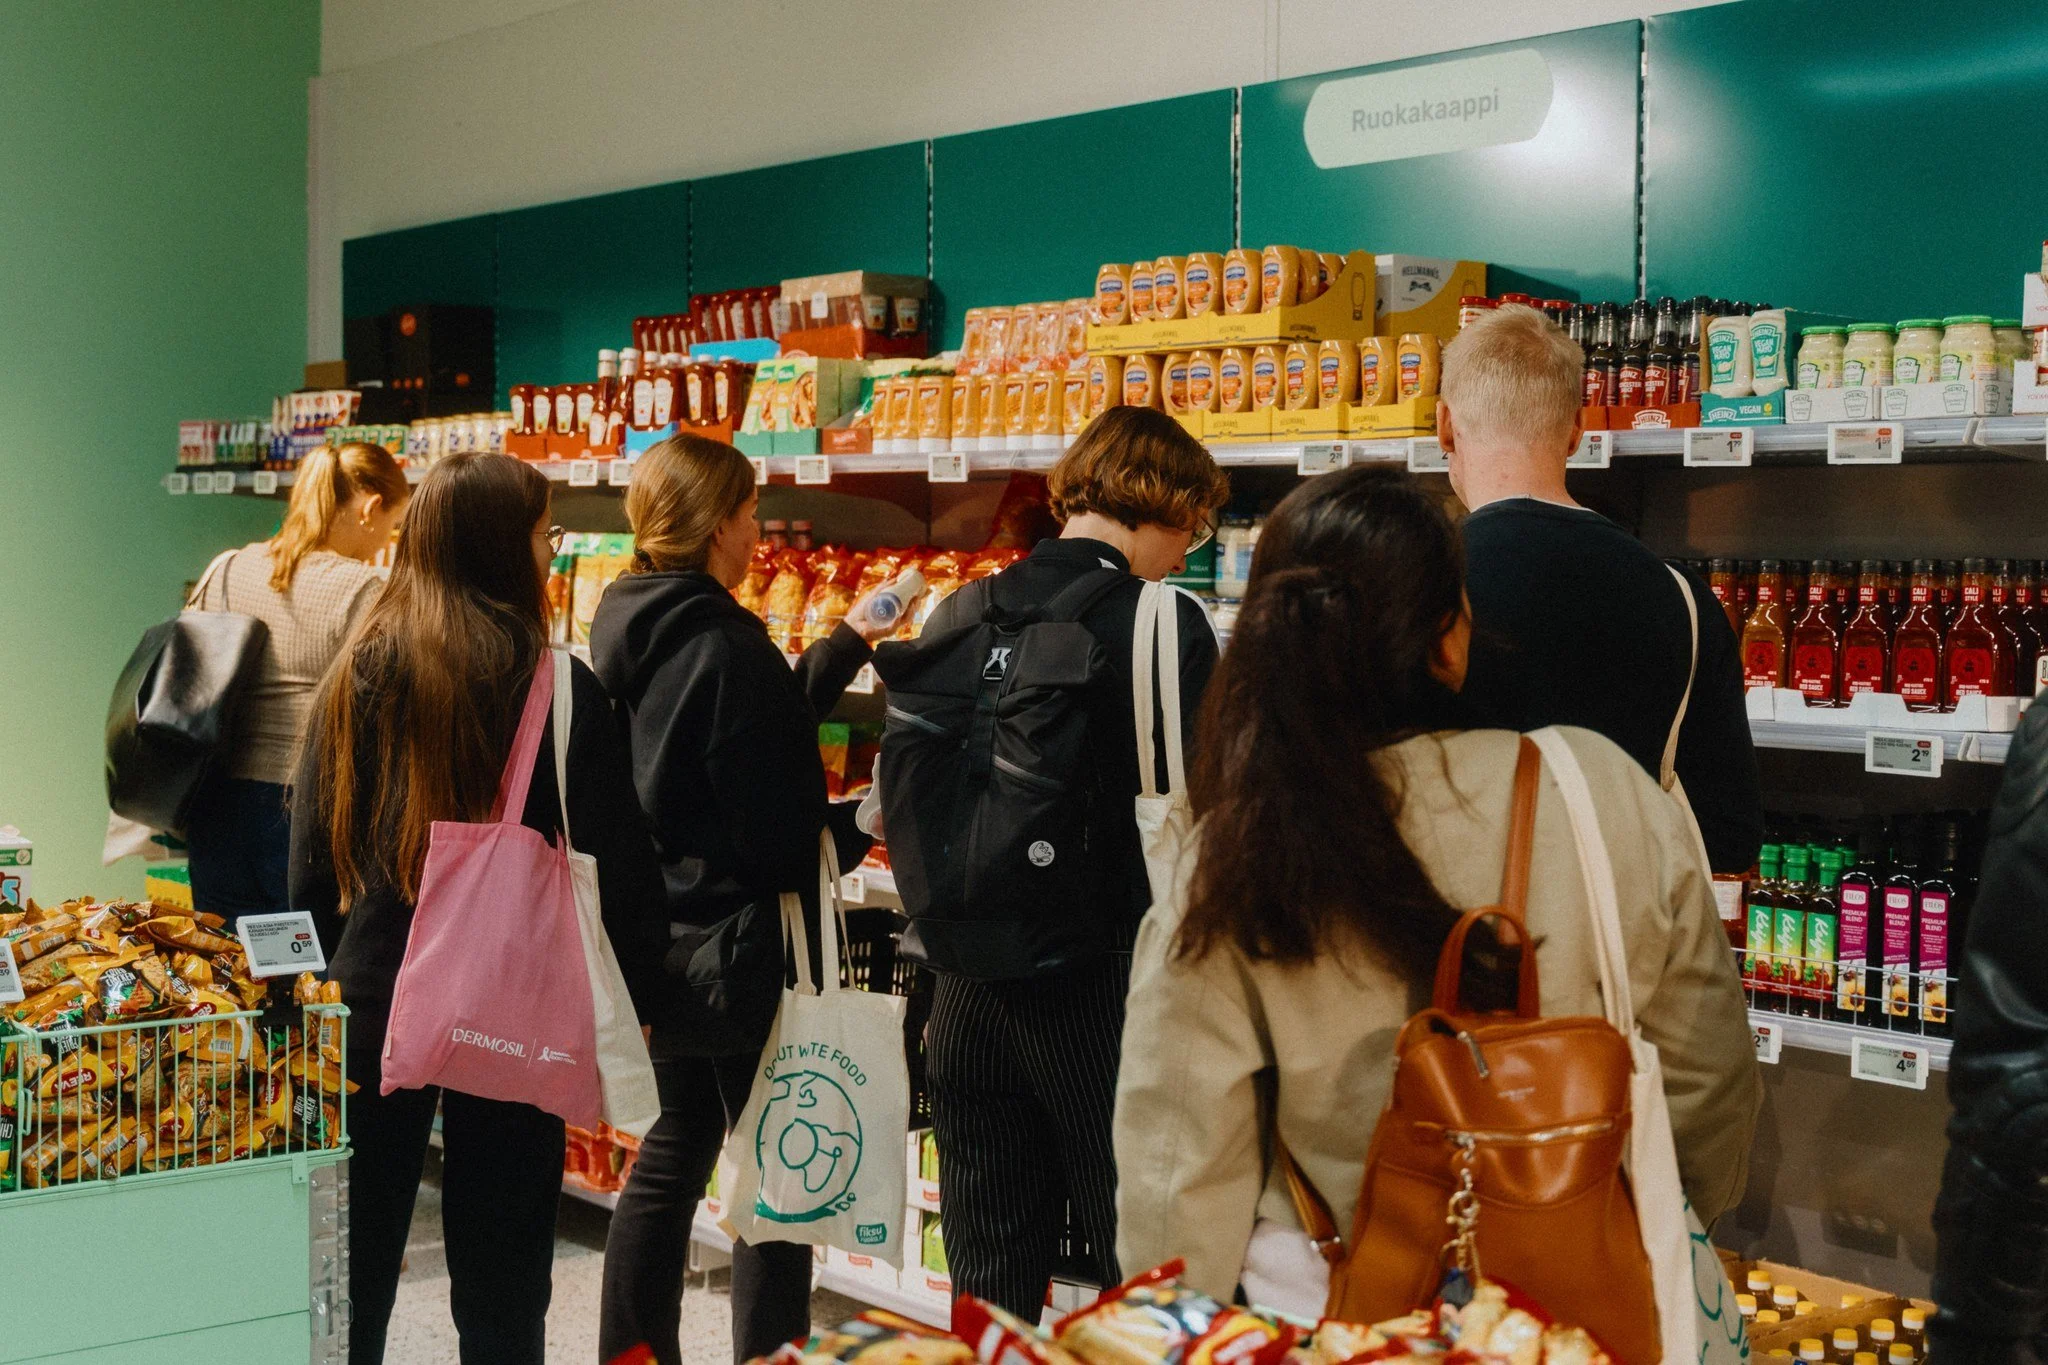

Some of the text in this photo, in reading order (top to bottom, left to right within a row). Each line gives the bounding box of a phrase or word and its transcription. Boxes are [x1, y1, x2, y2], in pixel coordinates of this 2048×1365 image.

[1352, 88, 1499, 132] Ruokakaappi
[1640, 414, 1660, 423] HEINZ
[1712, 405, 1761, 420] HEINZ VEGAN
[1842, 909, 1866, 917] PREMIUM
[1921, 918, 1946, 926] PREMIUM
[452, 1028, 527, 1058] DERMOSIL
[830, 1049, 867, 1086] FOOD
[860, 1226, 882, 1237] fiksu
